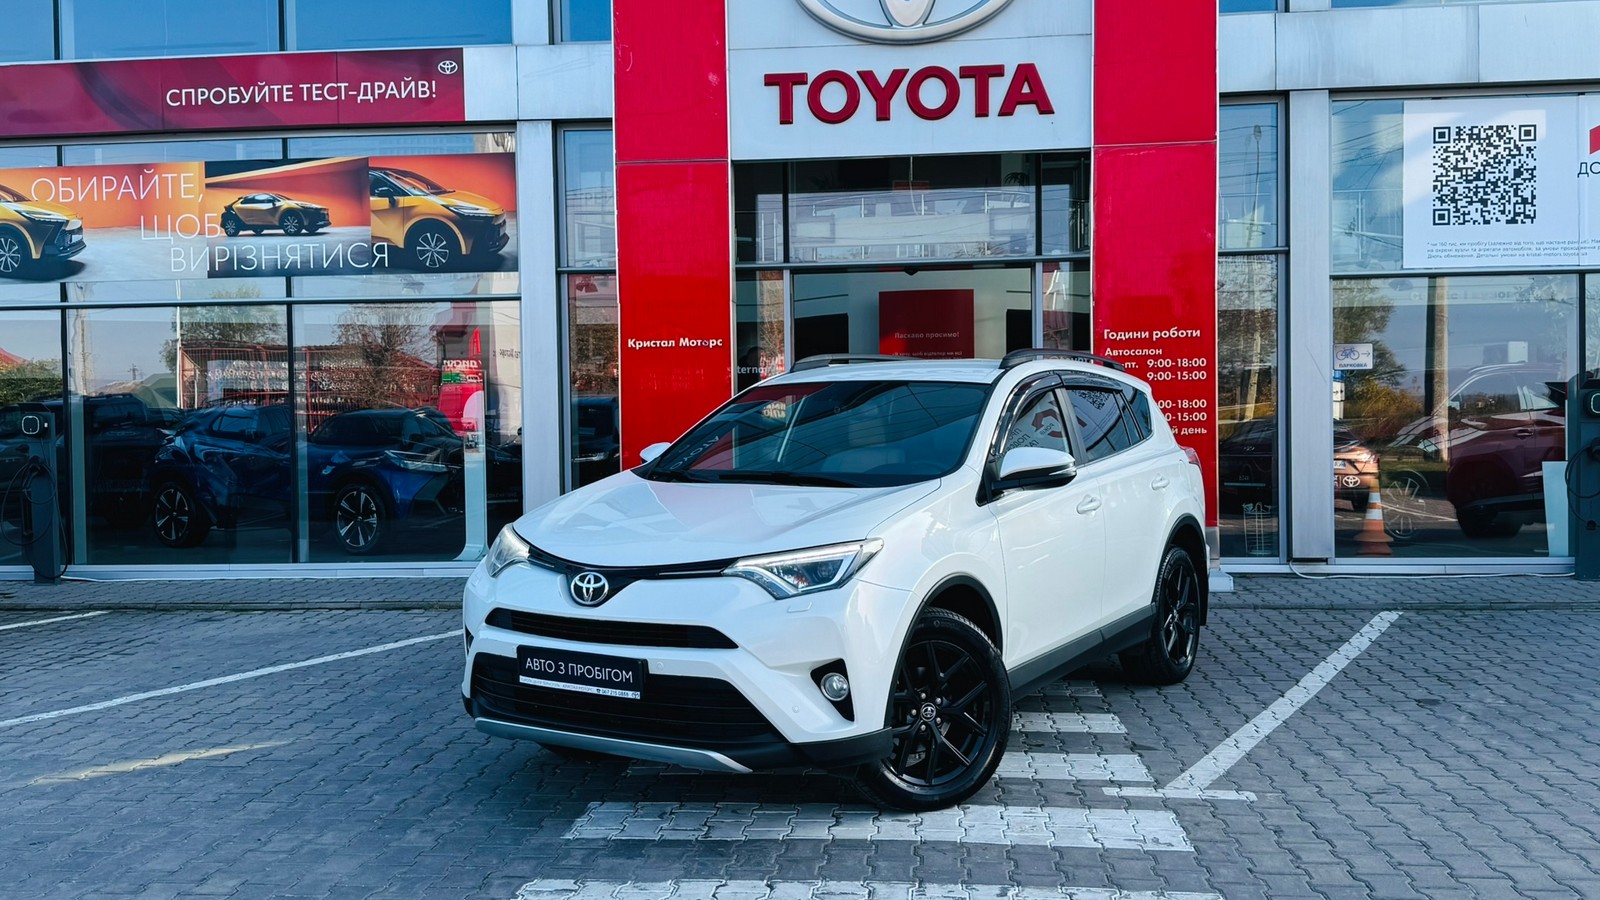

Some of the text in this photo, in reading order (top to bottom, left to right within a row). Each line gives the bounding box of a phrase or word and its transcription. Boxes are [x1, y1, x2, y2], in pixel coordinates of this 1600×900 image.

[166, 77, 437, 107] СПРОБУЙТЕ ТЕСТ-ДРАЙВ!
[764, 63, 1055, 125] TOYOTA
[31, 168, 203, 203] ОБИРАЙТЕ,
[140, 212, 221, 245] ЩОБ
[170, 242, 389, 273] ВИРІЗНЯТИСЯ
[628, 337, 723, 350] Кристал Моторс
[1103, 327, 1201, 341] Години роботи
[1105, 348, 1163, 356] Автосалон
[1146, 358, 1207, 368] 9:00-18:00
[1146, 371, 1207, 381] 9:00-15:00
[1180, 427, 1207, 436] день
[525, 657, 556, 673] АВТО
[568, 663, 633, 683] ПРОБІГОМ
